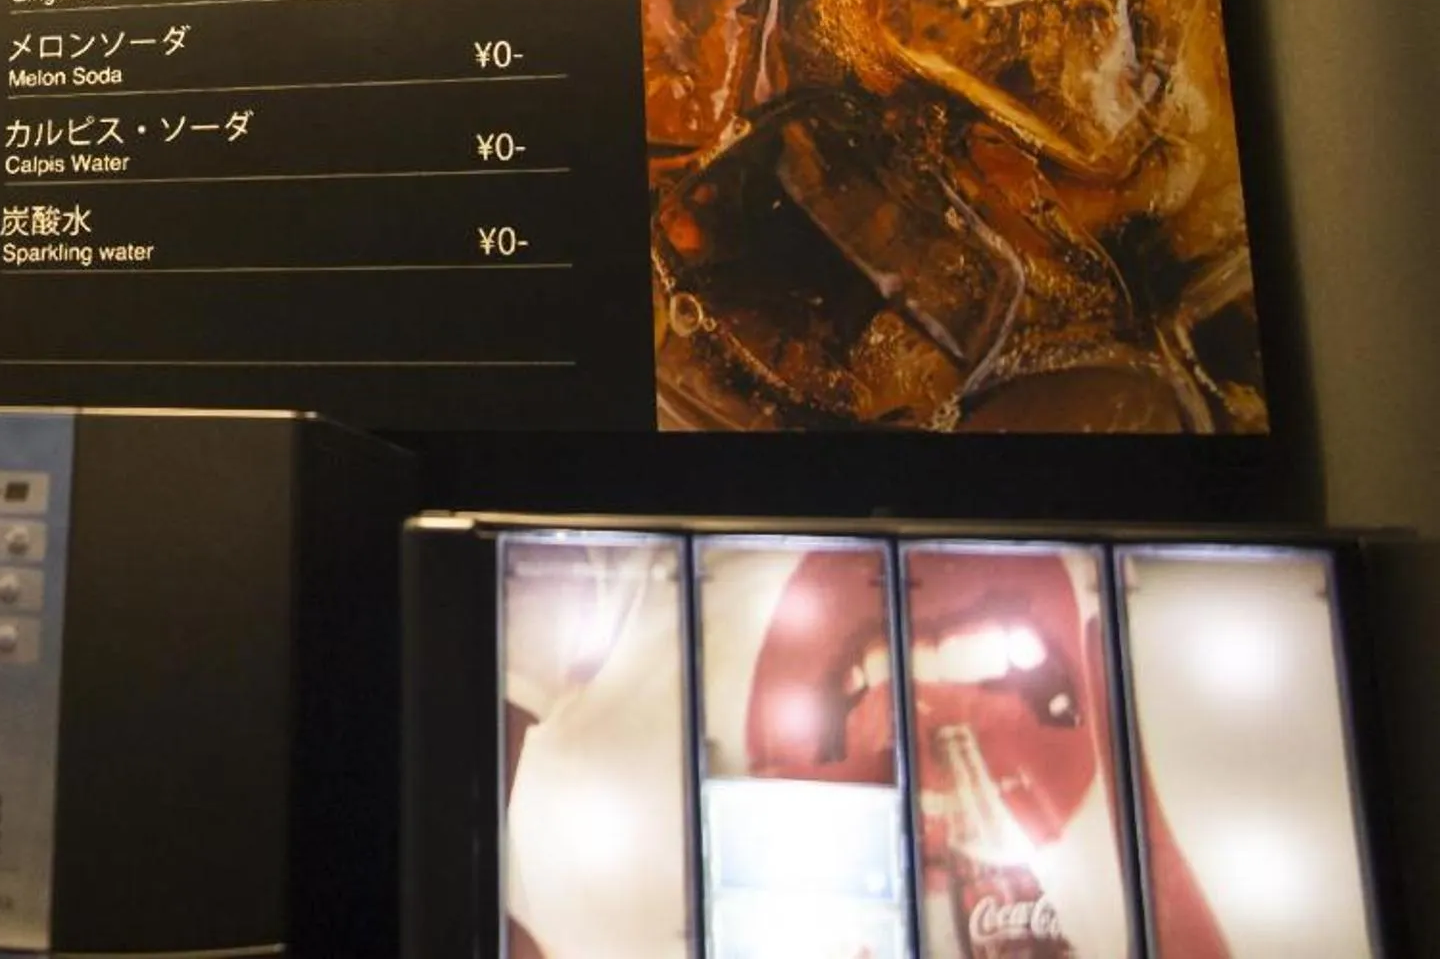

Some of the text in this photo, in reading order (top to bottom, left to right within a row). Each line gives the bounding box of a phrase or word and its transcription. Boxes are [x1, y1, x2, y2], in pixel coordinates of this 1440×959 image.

[8, 24, 191, 62] メロンソーダ
[8, 65, 122, 87] Melon Soda
[5, 153, 130, 177] Calpis Water
[0, 204, 92, 237] 炭酸水
[2, 242, 155, 267] Sparkling water
